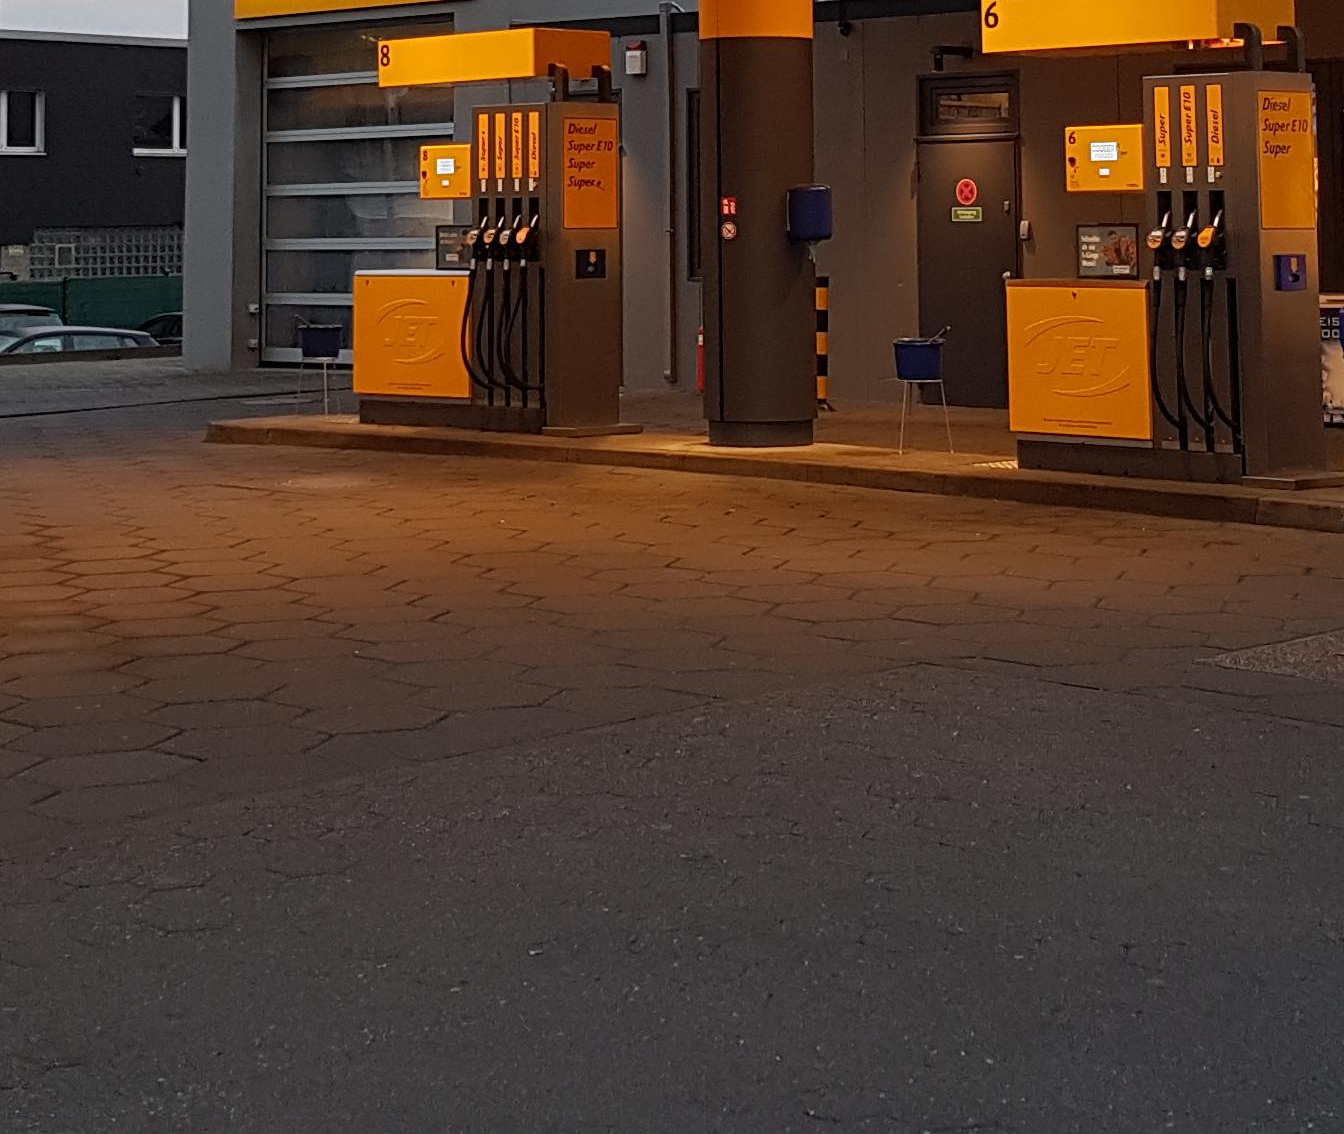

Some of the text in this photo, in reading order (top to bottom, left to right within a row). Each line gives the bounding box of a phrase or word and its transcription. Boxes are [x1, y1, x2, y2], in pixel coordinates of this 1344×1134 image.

[984, 0, 999, 29] 6
[380, 44, 391, 67] 8
[1262, 96, 1291, 113] Diesel
[568, 122, 598, 135] Diesel
[1183, 91, 1194, 145] Super E10
[1209, 109, 1220, 144] Diesel
[1262, 118, 1309, 139] Super E10
[1068, 130, 1077, 145] 6
[1158, 113, 1168, 146] Super
[422, 150, 429, 161] 8
[568, 140, 614, 154] Super E10
[1262, 143, 1292, 159] Super
[567, 157, 596, 173] Super
[384, 315, 439, 348] JET
[1035, 335, 1121, 377] JET
